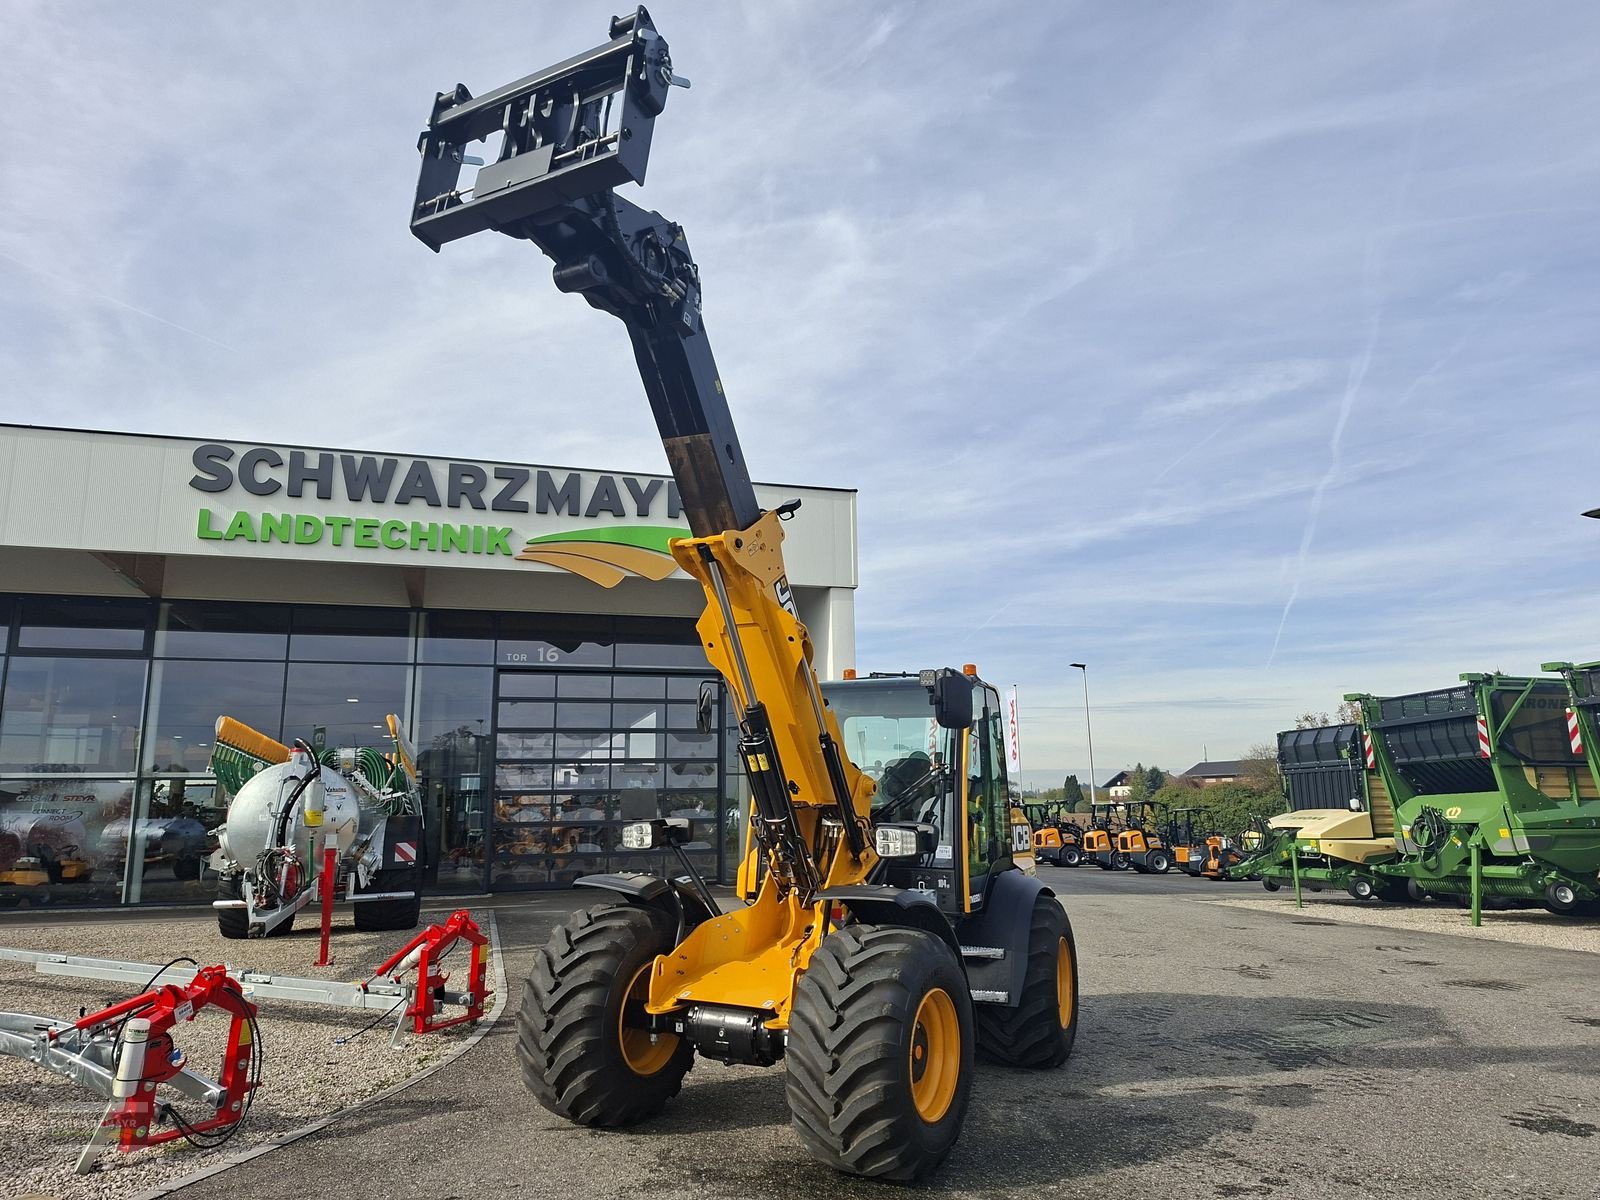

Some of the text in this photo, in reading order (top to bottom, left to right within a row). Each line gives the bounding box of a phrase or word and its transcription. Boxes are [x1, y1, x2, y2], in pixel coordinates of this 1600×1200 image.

[197, 508, 513, 555] LANDTECHNIK
[506, 647, 559, 662] TOR 16
[1011, 825, 1031, 852] JCB
